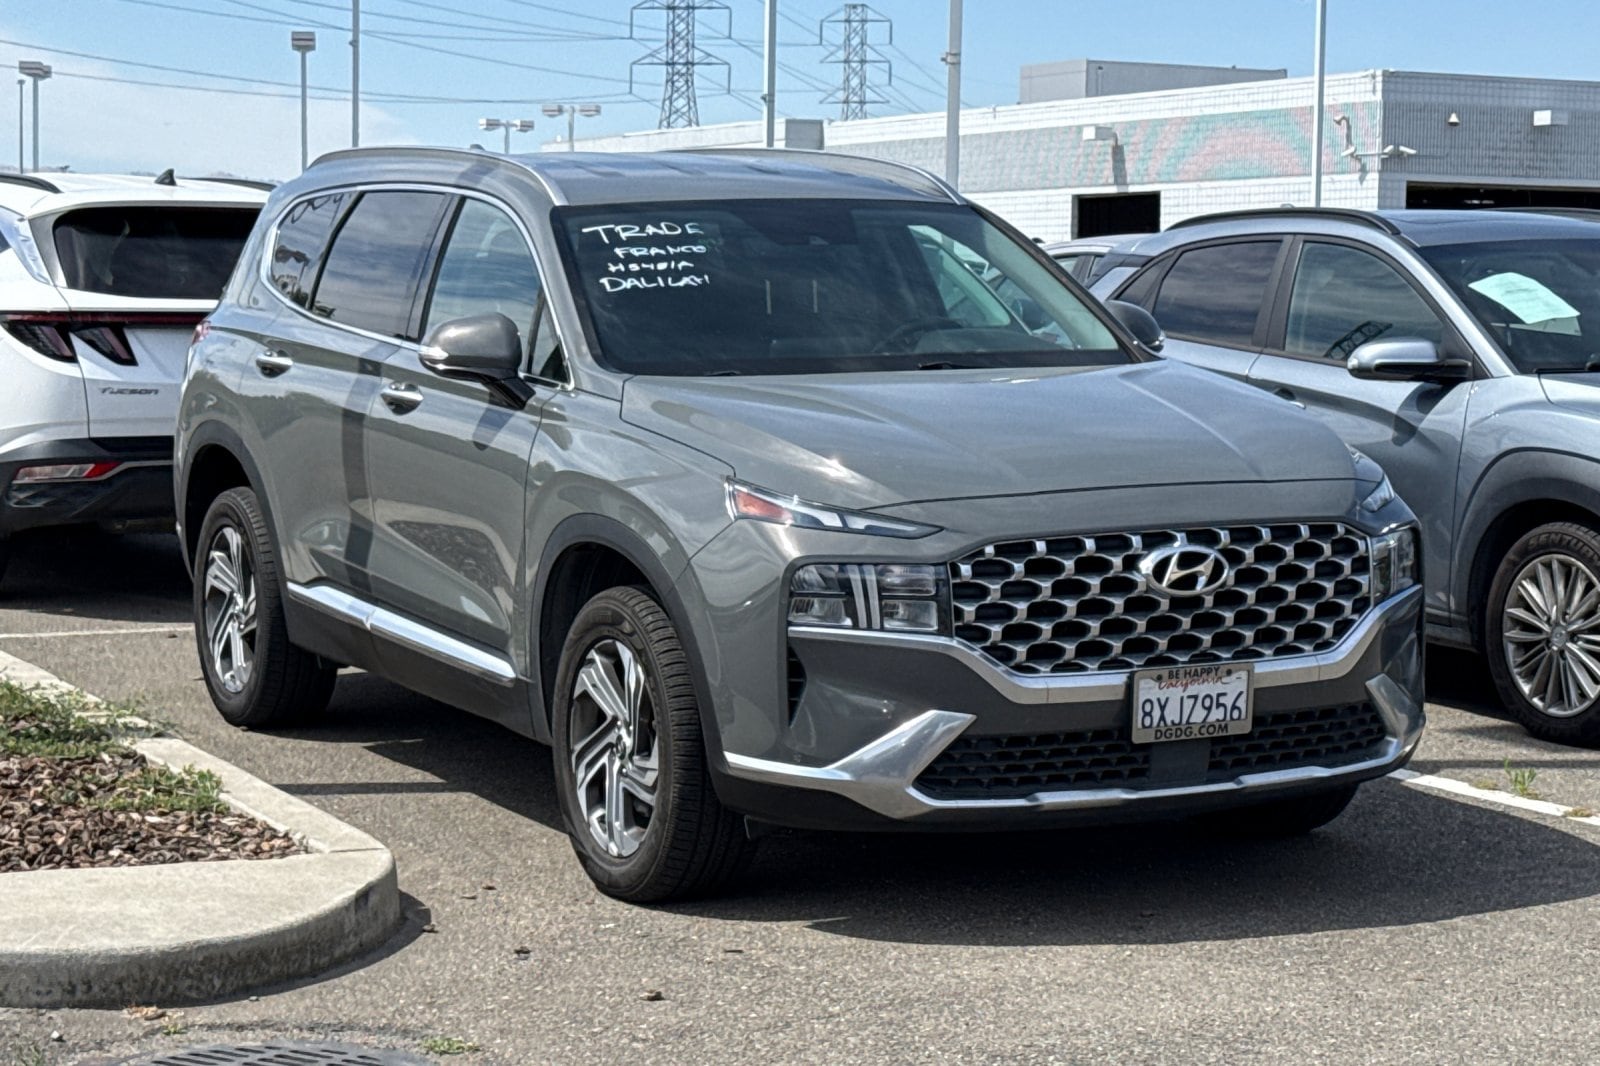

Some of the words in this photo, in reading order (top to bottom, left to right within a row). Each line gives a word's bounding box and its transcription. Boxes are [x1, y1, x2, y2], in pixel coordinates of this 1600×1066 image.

[582, 221, 704, 244] TRADE
[1167, 669, 1180, 680] BE
[1185, 666, 1220, 679] HAPPY
[1141, 691, 1244, 729] 8XJZ956
[1154, 723, 1229, 740] DGDG.COM
